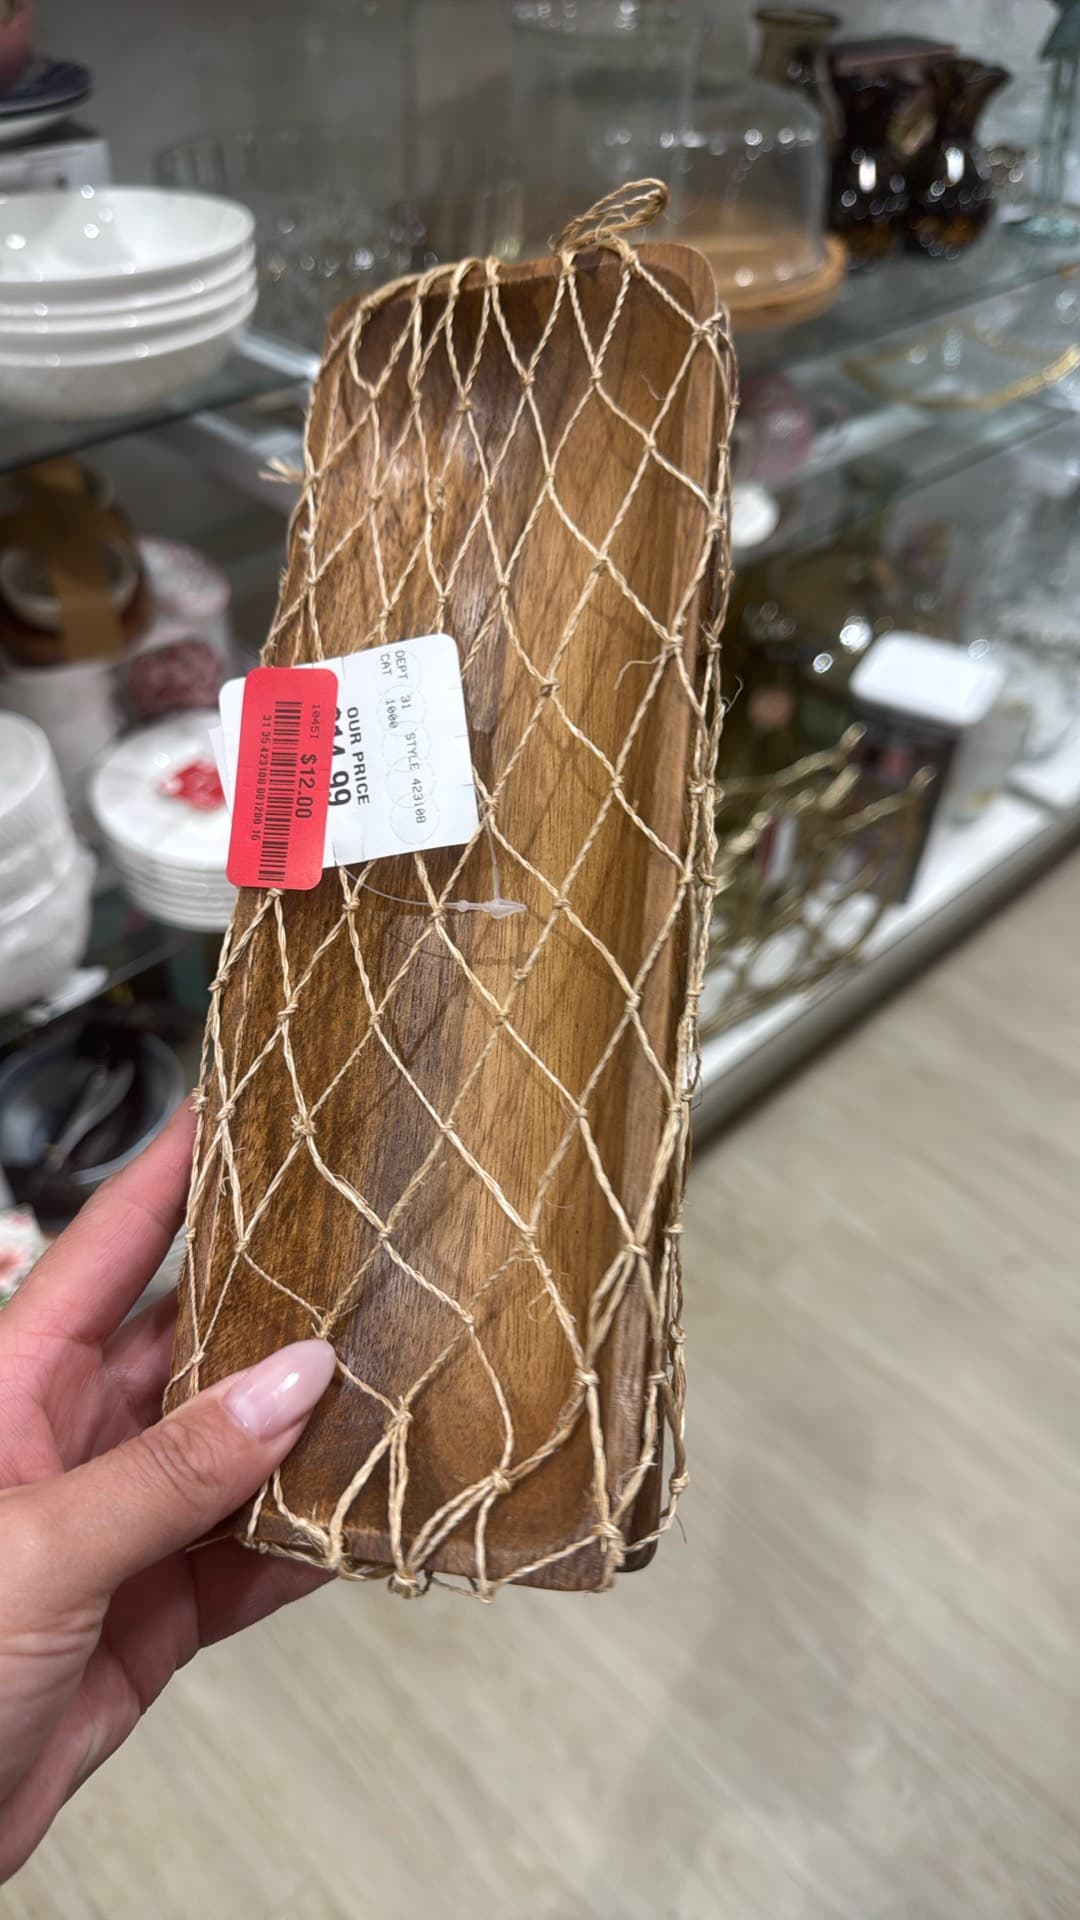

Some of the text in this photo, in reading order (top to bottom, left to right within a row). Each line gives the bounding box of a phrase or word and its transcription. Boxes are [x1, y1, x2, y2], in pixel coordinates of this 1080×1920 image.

[395, 650, 409, 679] DEPT
[380, 653, 399, 729] CAT 1000
[401, 695, 412, 709] 31
[261, 714, 272, 727] 31
[309, 704, 321, 739] 10451
[260, 731, 271, 744] 35
[405, 732, 420, 772] STYLE
[347, 706, 370, 806] OUR PRICE
[295, 754, 318, 819] $12.00
[251, 829, 261, 841] 16
